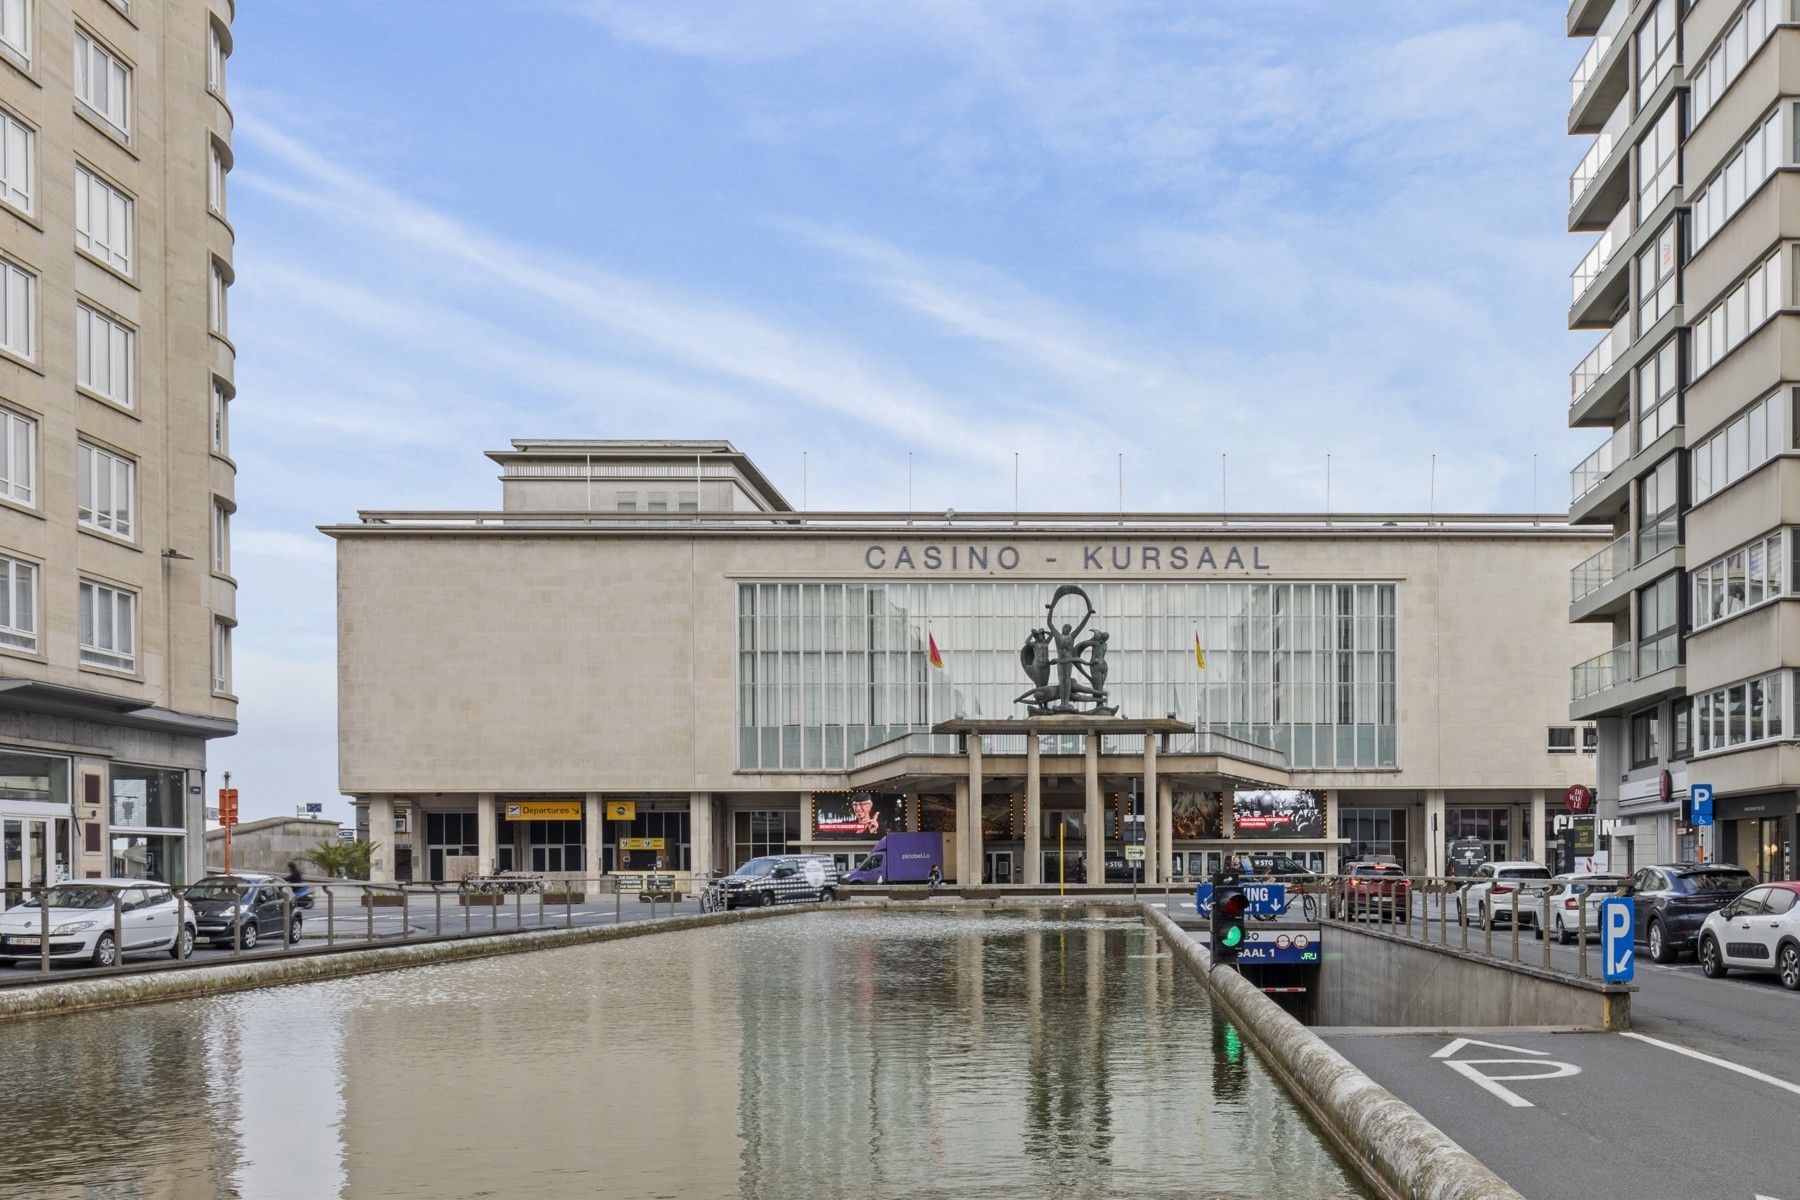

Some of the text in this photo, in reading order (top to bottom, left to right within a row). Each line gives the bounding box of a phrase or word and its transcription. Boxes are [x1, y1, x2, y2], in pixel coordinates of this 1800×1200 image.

[864, 545, 1020, 570] CASINO
[1084, 545, 1271, 570] KURSAAL
[1574, 788, 1584, 796] DE
[1694, 789, 1710, 811] P
[522, 806, 570, 815] Departures
[1607, 903, 1631, 976] P
[1269, 948, 1275, 958] 1
